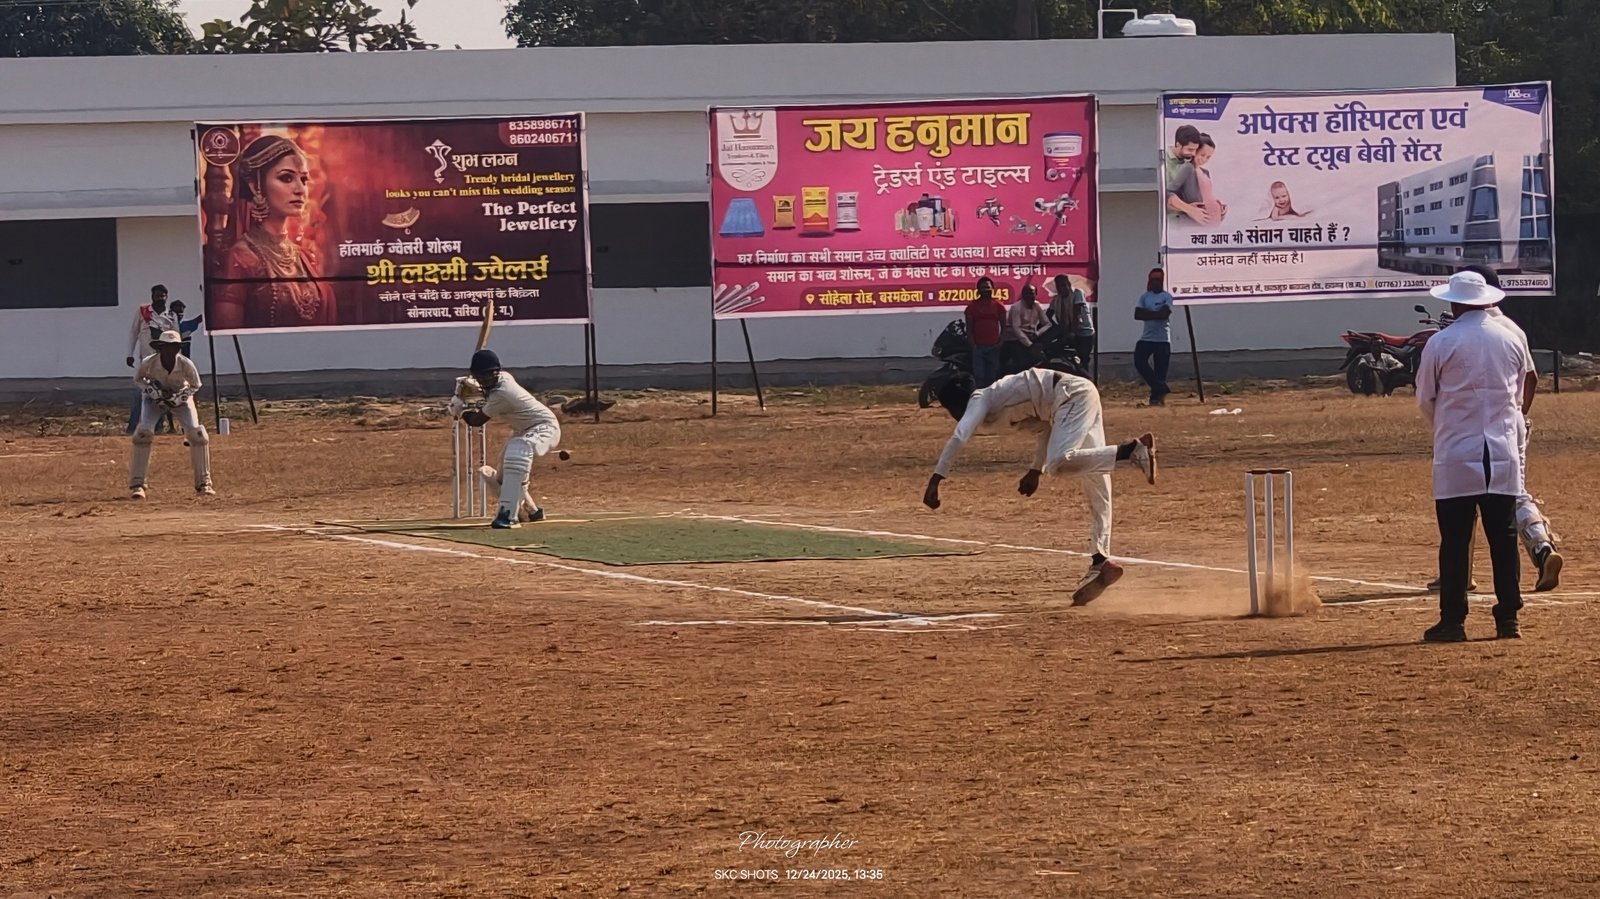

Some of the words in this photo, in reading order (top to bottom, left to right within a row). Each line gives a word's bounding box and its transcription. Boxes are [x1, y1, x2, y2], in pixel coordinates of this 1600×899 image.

[509, 118, 577, 131] 8358986711
[1237, 105, 1319, 134] अपेक्स
[1324, 101, 1425, 132] हॉस्पिटल
[1430, 102, 1469, 129] एवं
[802, 117, 879, 152] जय
[885, 112, 1032, 158] हनुमान
[452, 154, 479, 171] शुभ
[482, 153, 519, 168] लग्न
[1262, 141, 1300, 166] टेस्ट
[1305, 145, 1351, 171] ट्यूब
[1356, 137, 1397, 163] बेबी
[1401, 137, 1442, 162] सेंटर
[464, 174, 498, 185] Trendy
[501, 173, 530, 183] bridal
[532, 172, 575, 183] jewellery
[873, 162, 922, 195] ट्रेडर्स
[927, 161, 957, 190] एंड
[960, 165, 1031, 188] टाइल्स
[386, 189, 410, 198] looks
[413, 190, 430, 199] you
[433, 187, 457, 196] can't
[460, 187, 480, 196] miss
[483, 186, 500, 195] this
[503, 186, 543, 196] wedding
[545, 186, 575, 194] season
[482, 202, 513, 216] The
[517, 200, 577, 215] Perfect
[500, 217, 577, 232] Jewellery
[1191, 234, 1207, 245] क्या
[1210, 234, 1228, 245] आप
[1232, 231, 1243, 244] भी
[1246, 226, 1284, 243] संतान
[1288, 223, 1323, 243] चाहते
[1327, 222, 1337, 242] हैं
[1342, 226, 1350, 241] ?
[339, 239, 384, 257] हॉलमार्क
[387, 238, 423, 255] ज्वेलरी
[426, 237, 462, 254] शोरूम
[737, 254, 753, 264] घर
[755, 249, 788, 264] निर्माण
[790, 252, 806, 263] का
[807, 248, 831, 263] सभी
[834, 250, 863, 262] समान
[865, 249, 886, 261] उच्च
[889, 245, 930, 261] क्वालिटी
[933, 247, 946, 259] पर
[992, 245, 1026, 258] टाइल्स
[1029, 246, 1037, 257] व
[1196, 254, 1234, 267] असंभव
[1236, 252, 1258, 265] नहीं
[1260, 251, 1288, 264] संभव
[367, 259, 396, 285] श्री
[400, 256, 468, 284] लक्ष्मी
[472, 255, 549, 281] ज्वेलर्स
[767, 271, 796, 282] समान
[798, 270, 814, 281] का
[950, 266, 965, 277] का
[967, 266, 986, 278] एक
[988, 265, 1009, 276] मात्र
[402, 290, 416, 303] एवं
[440, 289, 452, 300] के
[495, 288, 507, 298] के
[508, 287, 540, 298] विक्रेता
[818, 289, 852, 305] सोहेला
[855, 289, 876, 305] रोड,
[879, 288, 923, 303] बरमकेला
